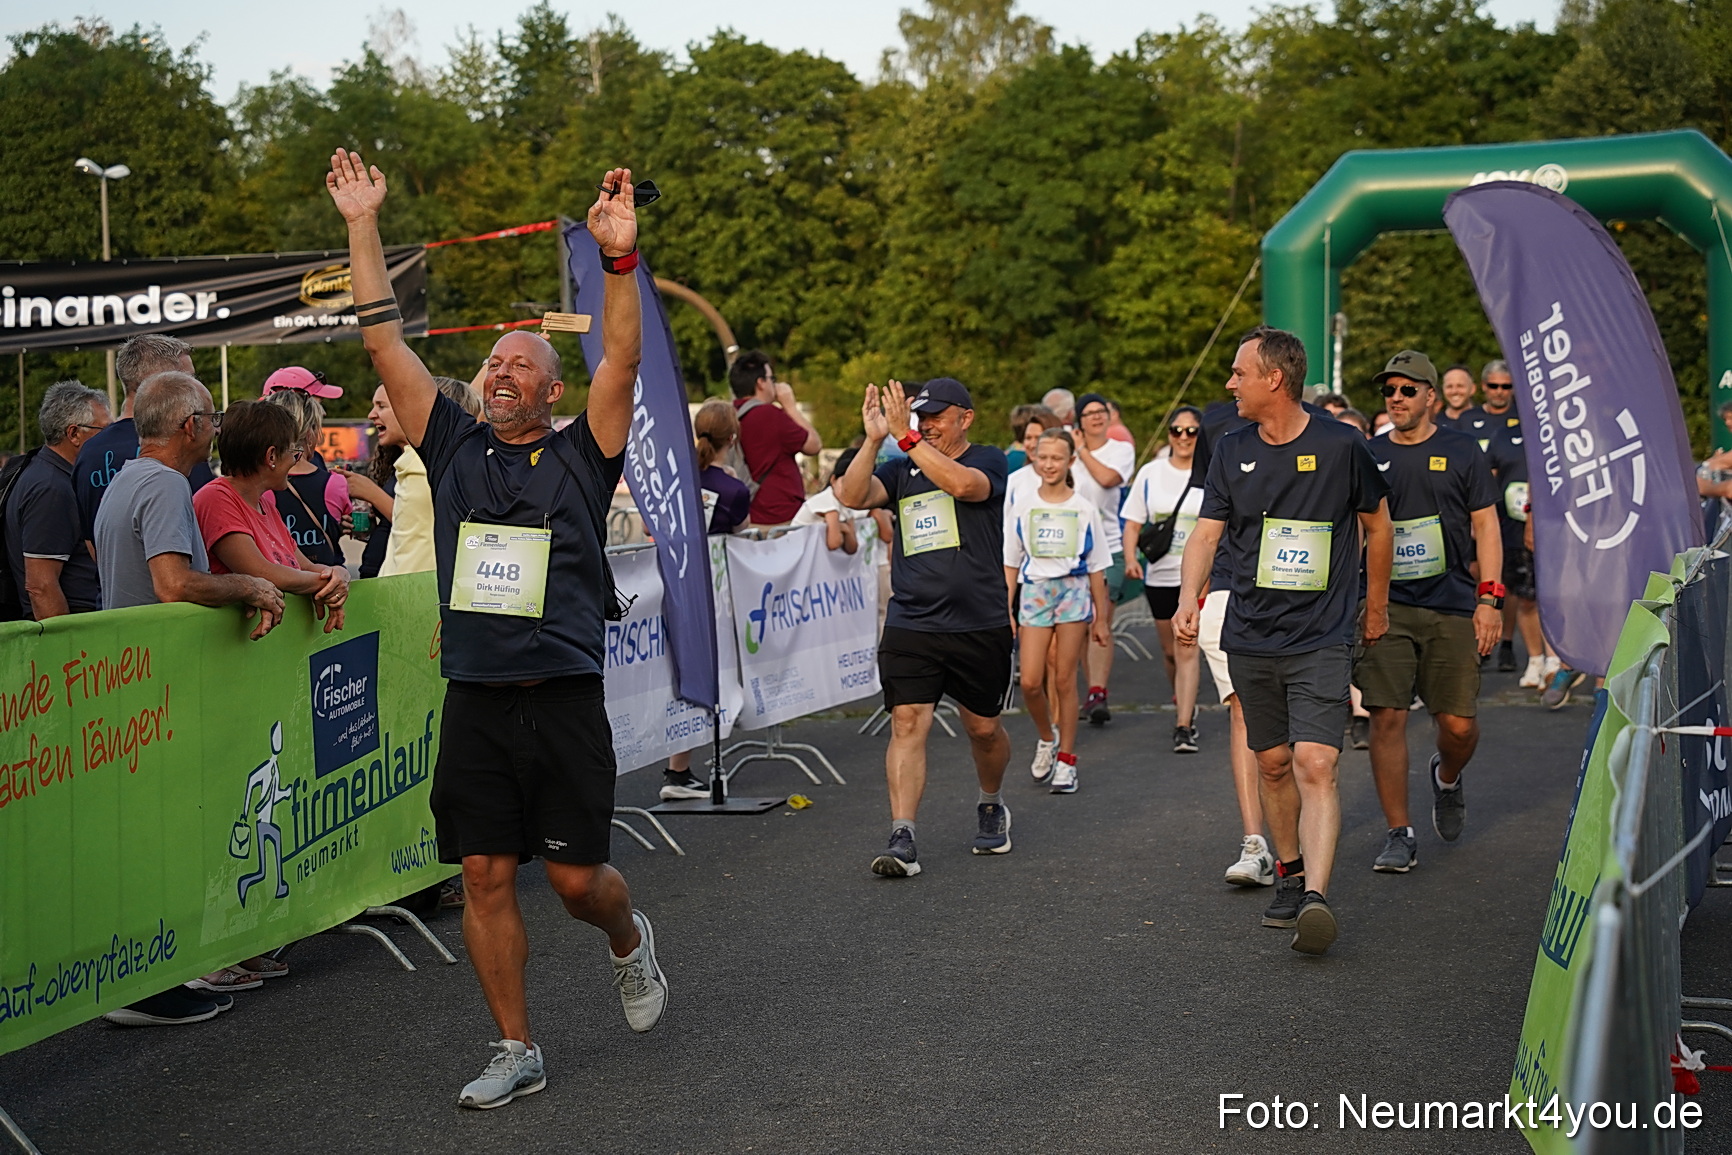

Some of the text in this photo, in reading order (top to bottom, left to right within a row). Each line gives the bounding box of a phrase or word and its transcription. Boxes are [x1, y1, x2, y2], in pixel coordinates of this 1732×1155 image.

[0, 285, 231, 328] inander.
[273, 315, 292, 328] Ein
[294, 315, 317, 327] Ort,
[318, 314, 340, 326] der
[916, 516, 938, 530] 451
[1038, 528, 1064, 539] 2719
[1277, 549, 1309, 564] 472
[1396, 544, 1427, 558] 466
[476, 561, 521, 582] 448
[1272, 565, 1293, 573] Steven
[476, 583, 521, 596] Dirk Hüfing
[63, 646, 151, 707] Firmen
[323, 675, 368, 710] Fischer
[328, 696, 365, 721] AUTOMOBILE
[82, 684, 173, 774] länger!
[292, 709, 434, 850] firmenlauf
[296, 823, 359, 884] neumarkt
